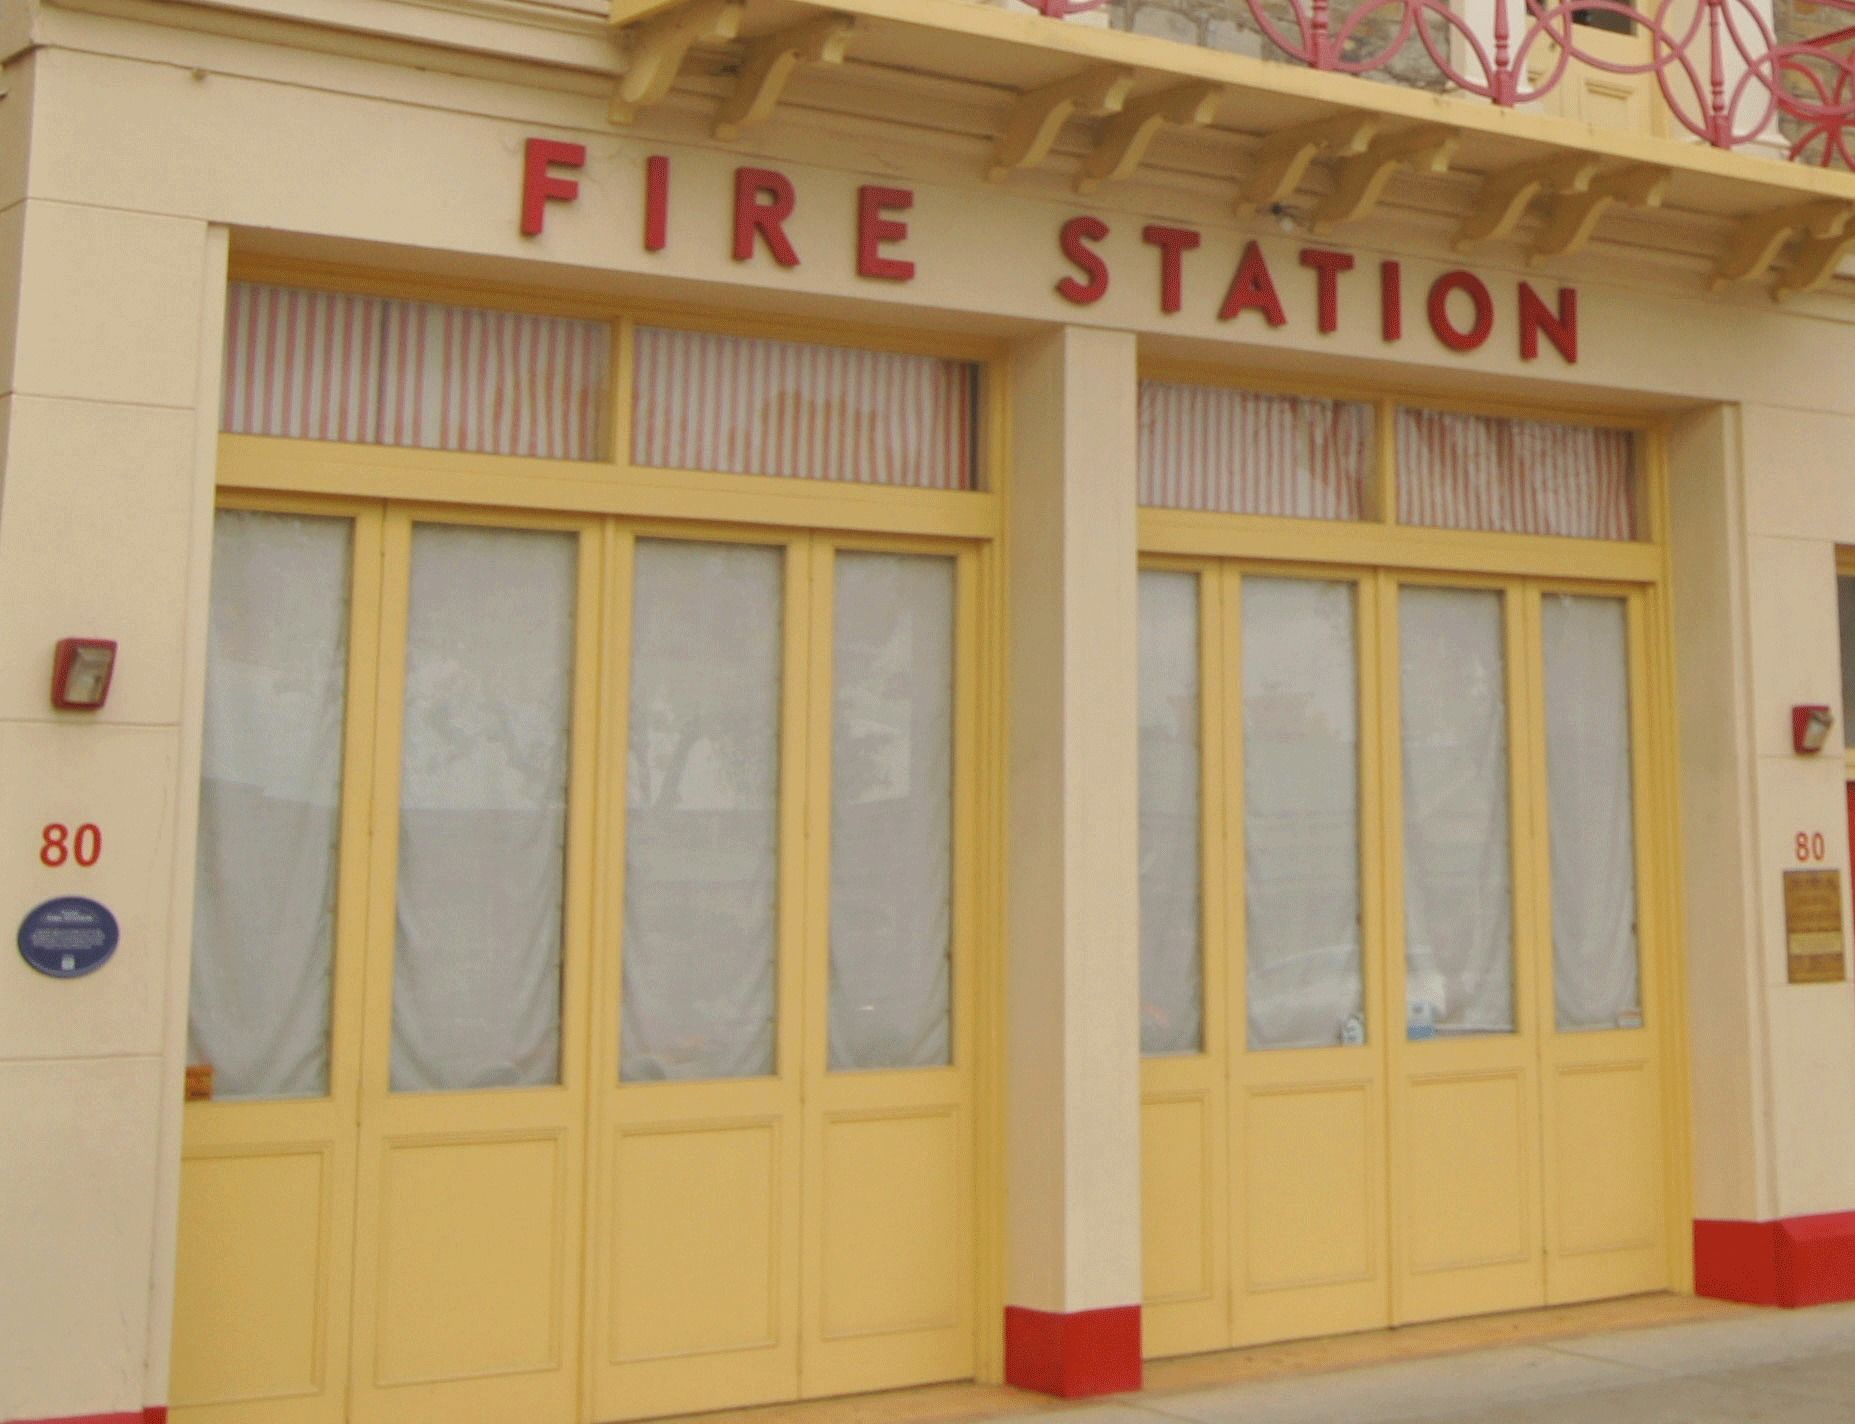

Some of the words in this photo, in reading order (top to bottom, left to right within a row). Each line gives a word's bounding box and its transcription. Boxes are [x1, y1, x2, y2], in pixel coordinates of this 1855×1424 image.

[520, 137, 916, 282] FIRE
[1055, 216, 1579, 364] STATION
[40, 823, 102, 867] 80
[1795, 832, 1825, 861] 80
